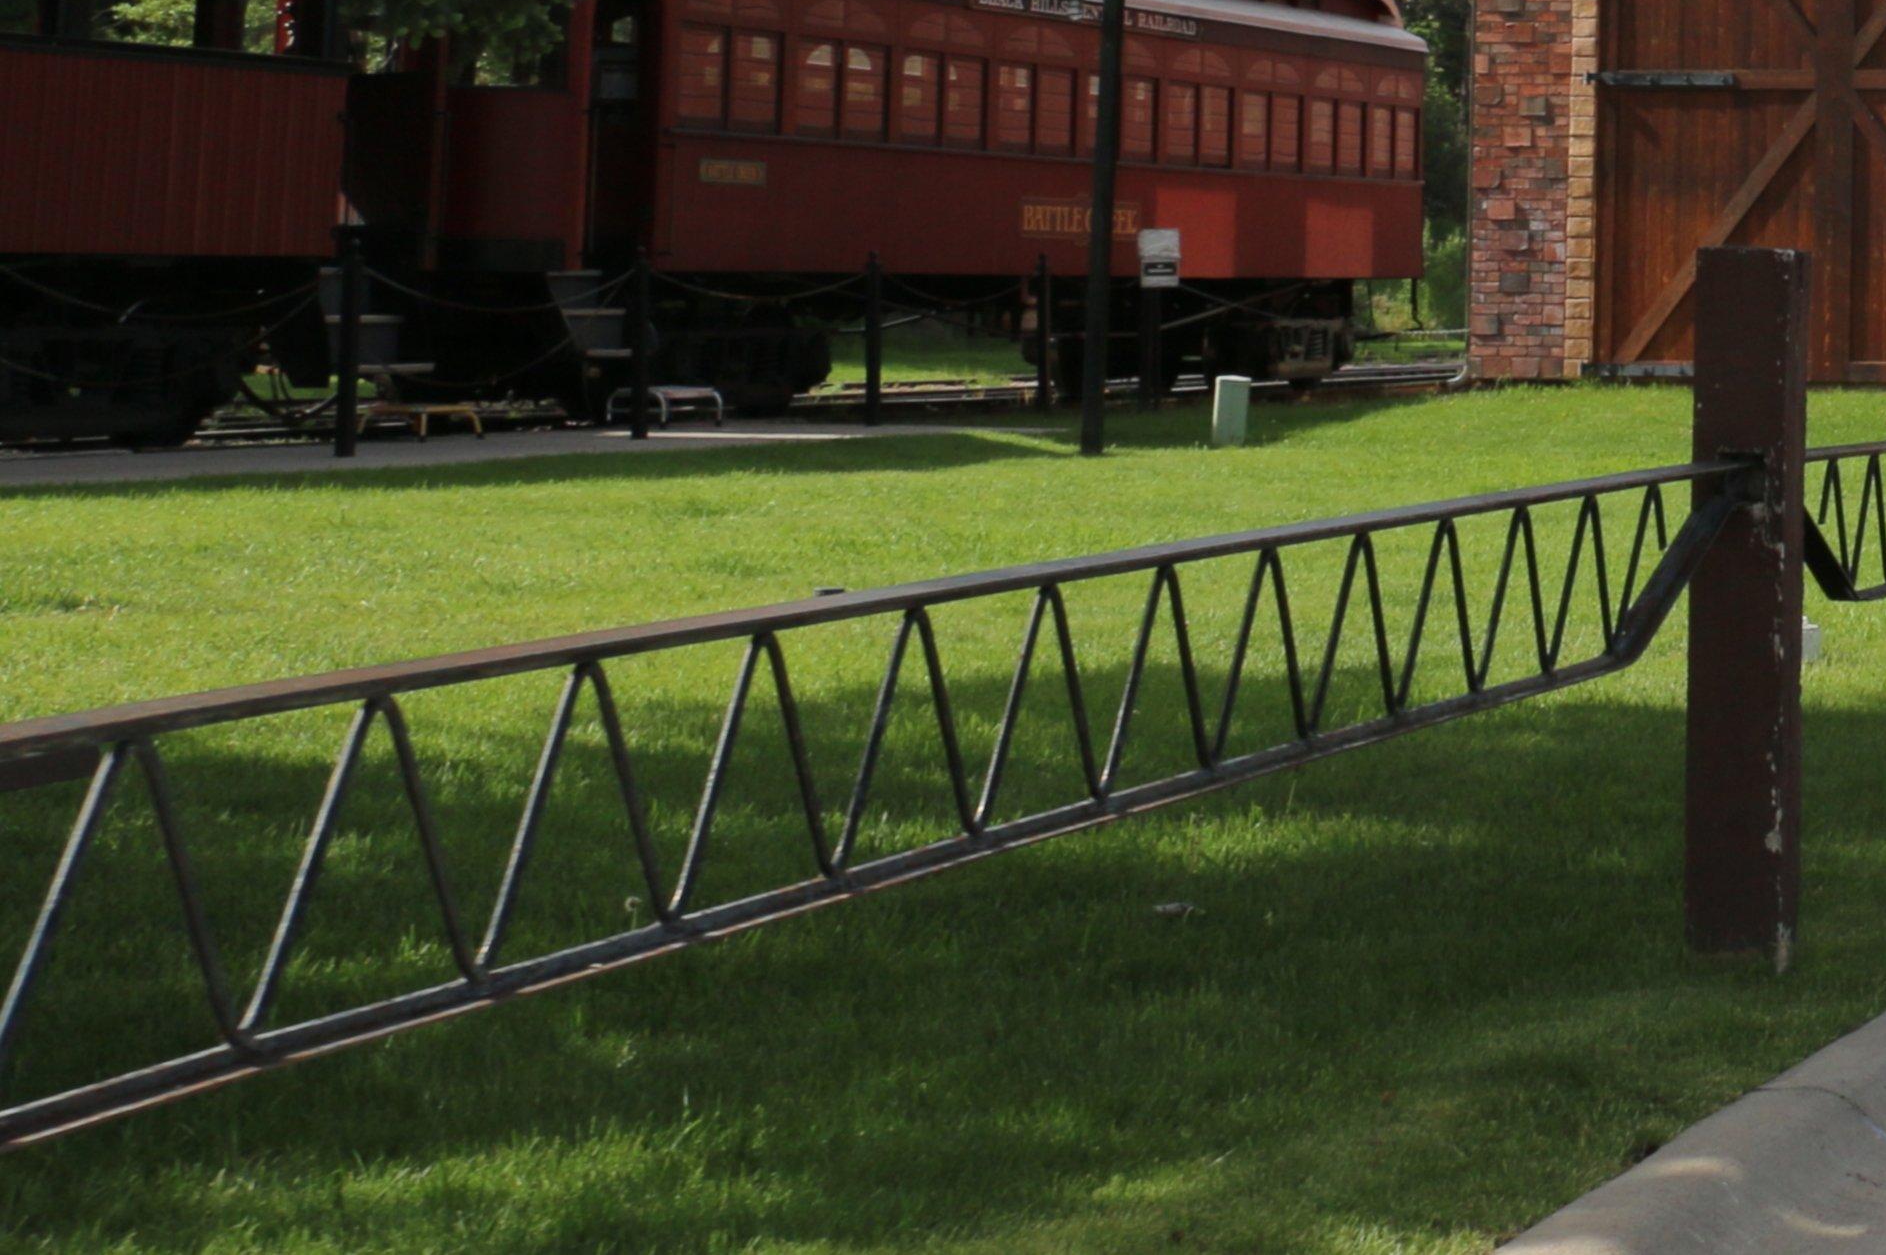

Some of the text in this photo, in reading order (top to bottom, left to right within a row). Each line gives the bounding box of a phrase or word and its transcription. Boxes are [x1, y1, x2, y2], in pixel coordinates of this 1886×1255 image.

[1138, 12, 1197, 36] RAILROAD
[1023, 204, 1138, 234] BATTLE CEK
